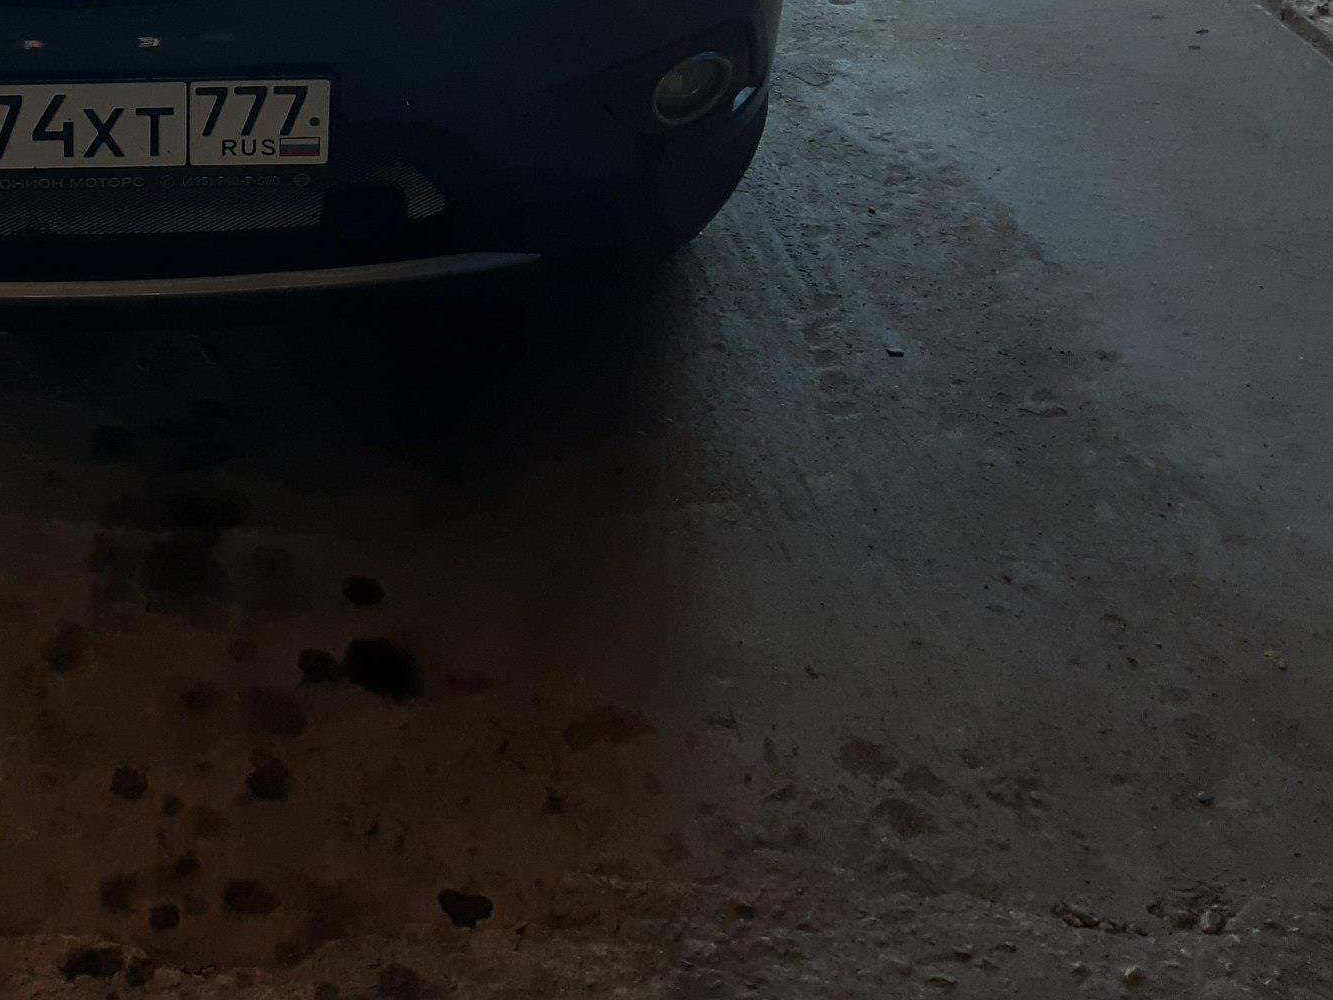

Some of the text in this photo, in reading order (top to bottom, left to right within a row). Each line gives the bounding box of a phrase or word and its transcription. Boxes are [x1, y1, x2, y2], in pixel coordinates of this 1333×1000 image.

[195, 86, 308, 136] 777
[221, 138, 276, 156] RUS
[70, 176, 146, 188] МОТОРС
